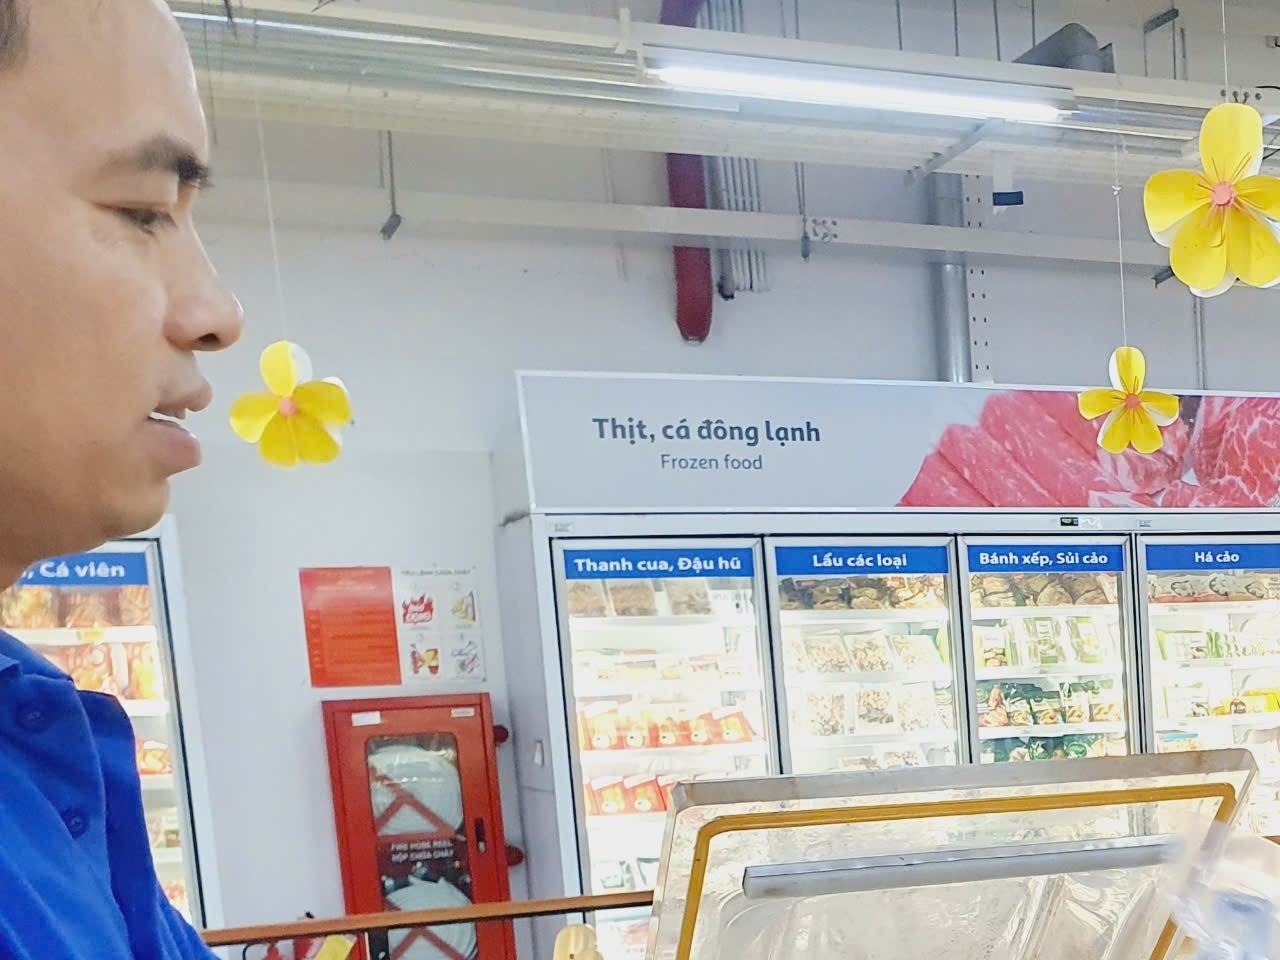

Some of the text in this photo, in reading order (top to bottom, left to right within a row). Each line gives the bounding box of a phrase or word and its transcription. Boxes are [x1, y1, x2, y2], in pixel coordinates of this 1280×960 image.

[592, 417, 821, 447] Thịt, cá đông lạnh
[660, 454, 763, 470] Frozen food
[574, 556, 741, 573] Thanh cua, Đậu hũ
[846, 553, 874, 567] các
[877, 553, 907, 569] loại
[979, 551, 1019, 565] Bánh
[1022, 551, 1053, 567] xếp,
[1082, 551, 1108, 564] cảo
[1194, 550, 1240, 563] Há cảo
[39, 561, 69, 578] Cá
[75, 561, 126, 578] viên
